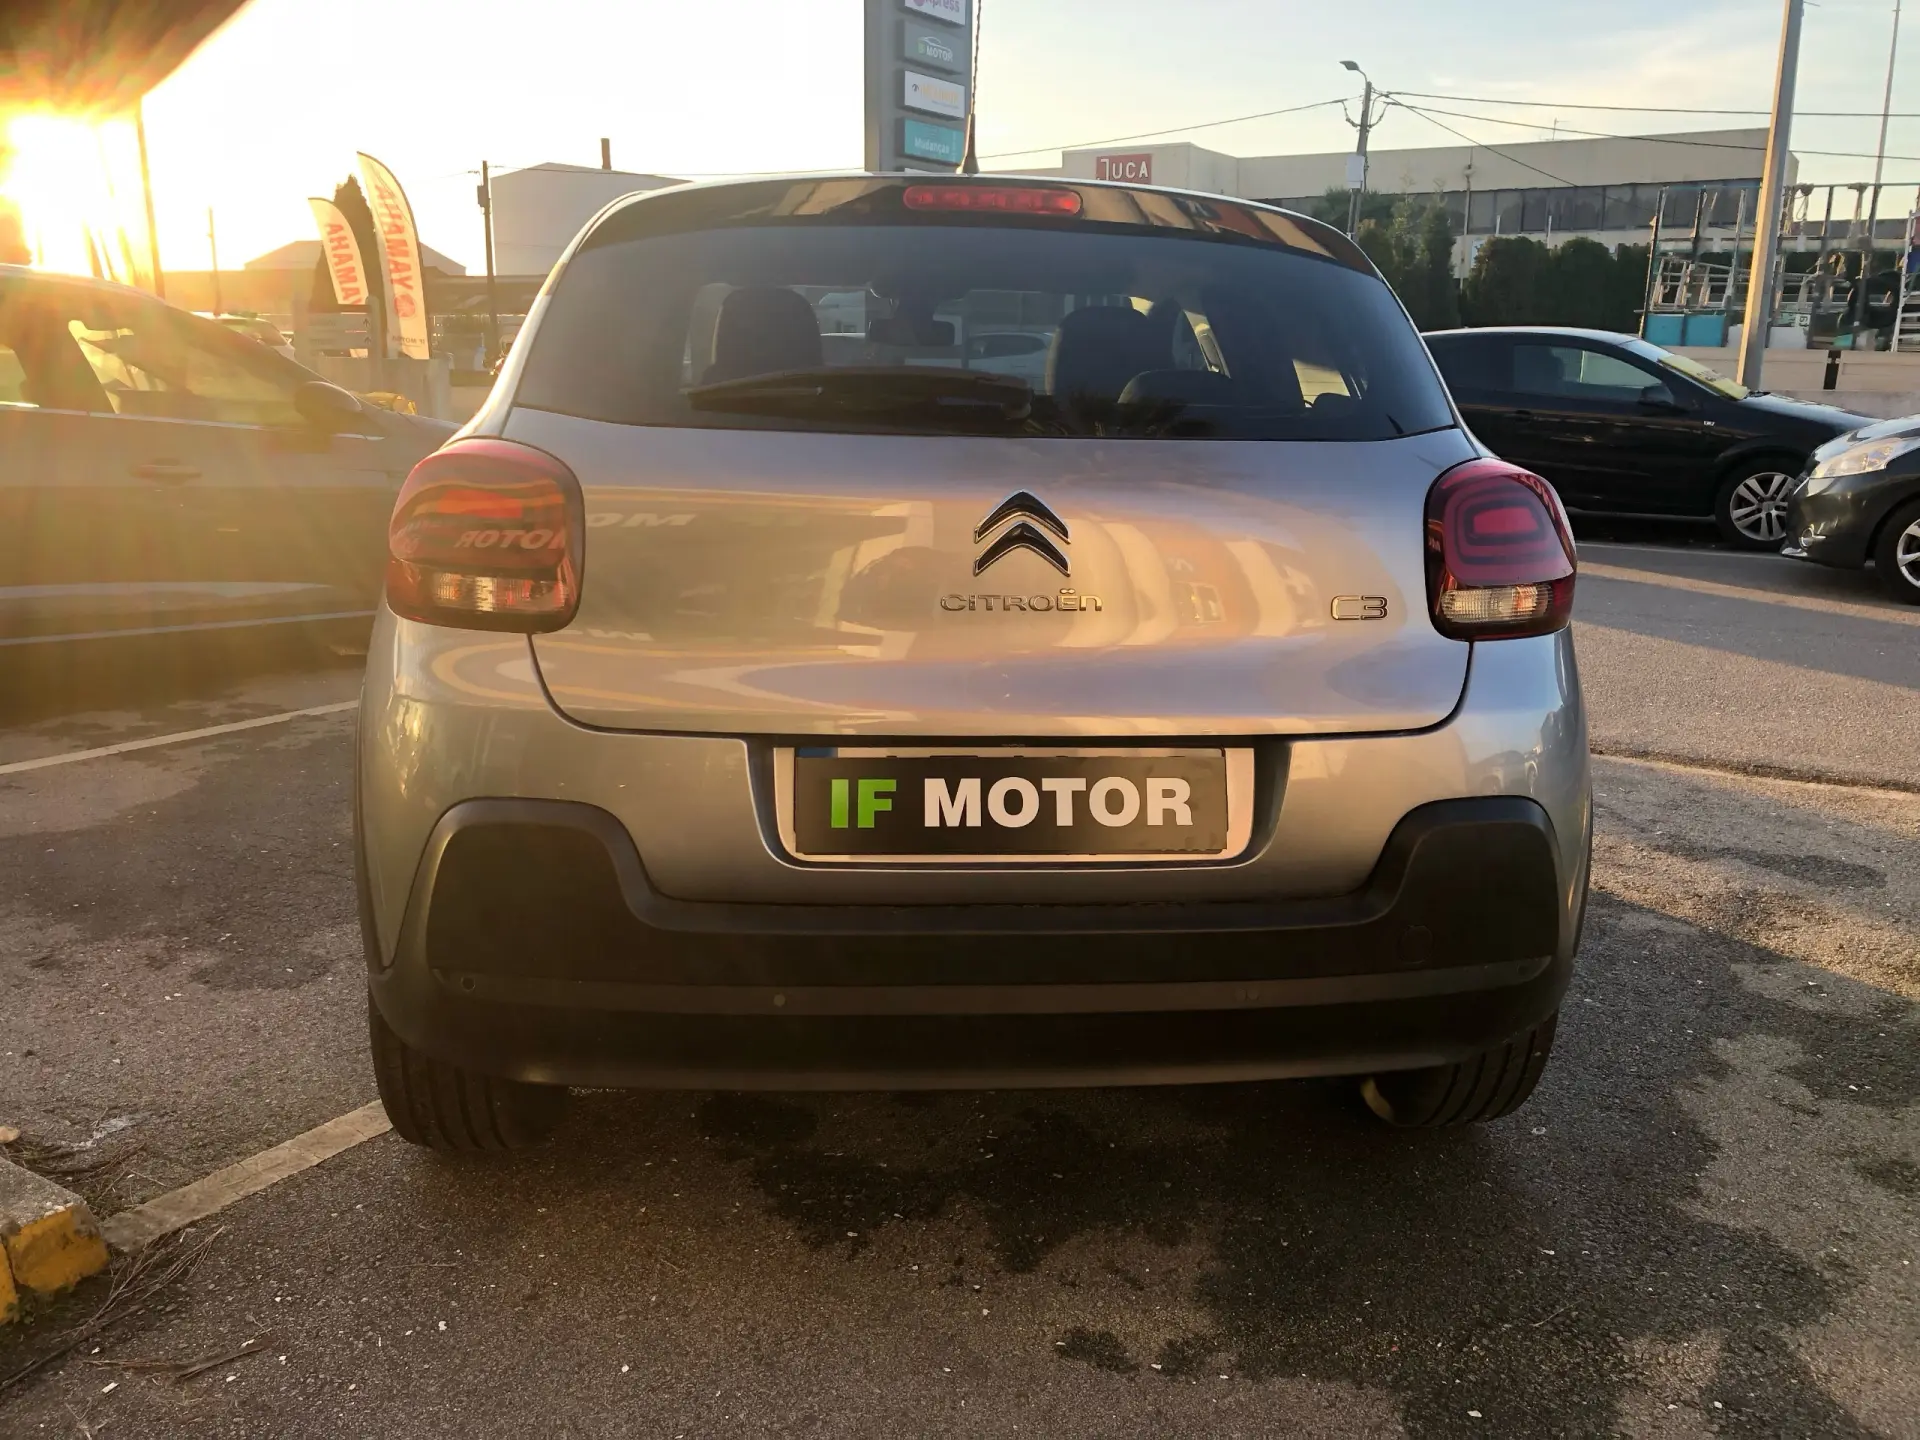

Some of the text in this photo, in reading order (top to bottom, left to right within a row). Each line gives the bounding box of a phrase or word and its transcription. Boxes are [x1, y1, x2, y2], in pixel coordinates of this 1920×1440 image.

[926, 45, 953, 62] MOTOR
[1330, 595, 1388, 620] C3
[830, 777, 1194, 829] IF MOTOR
